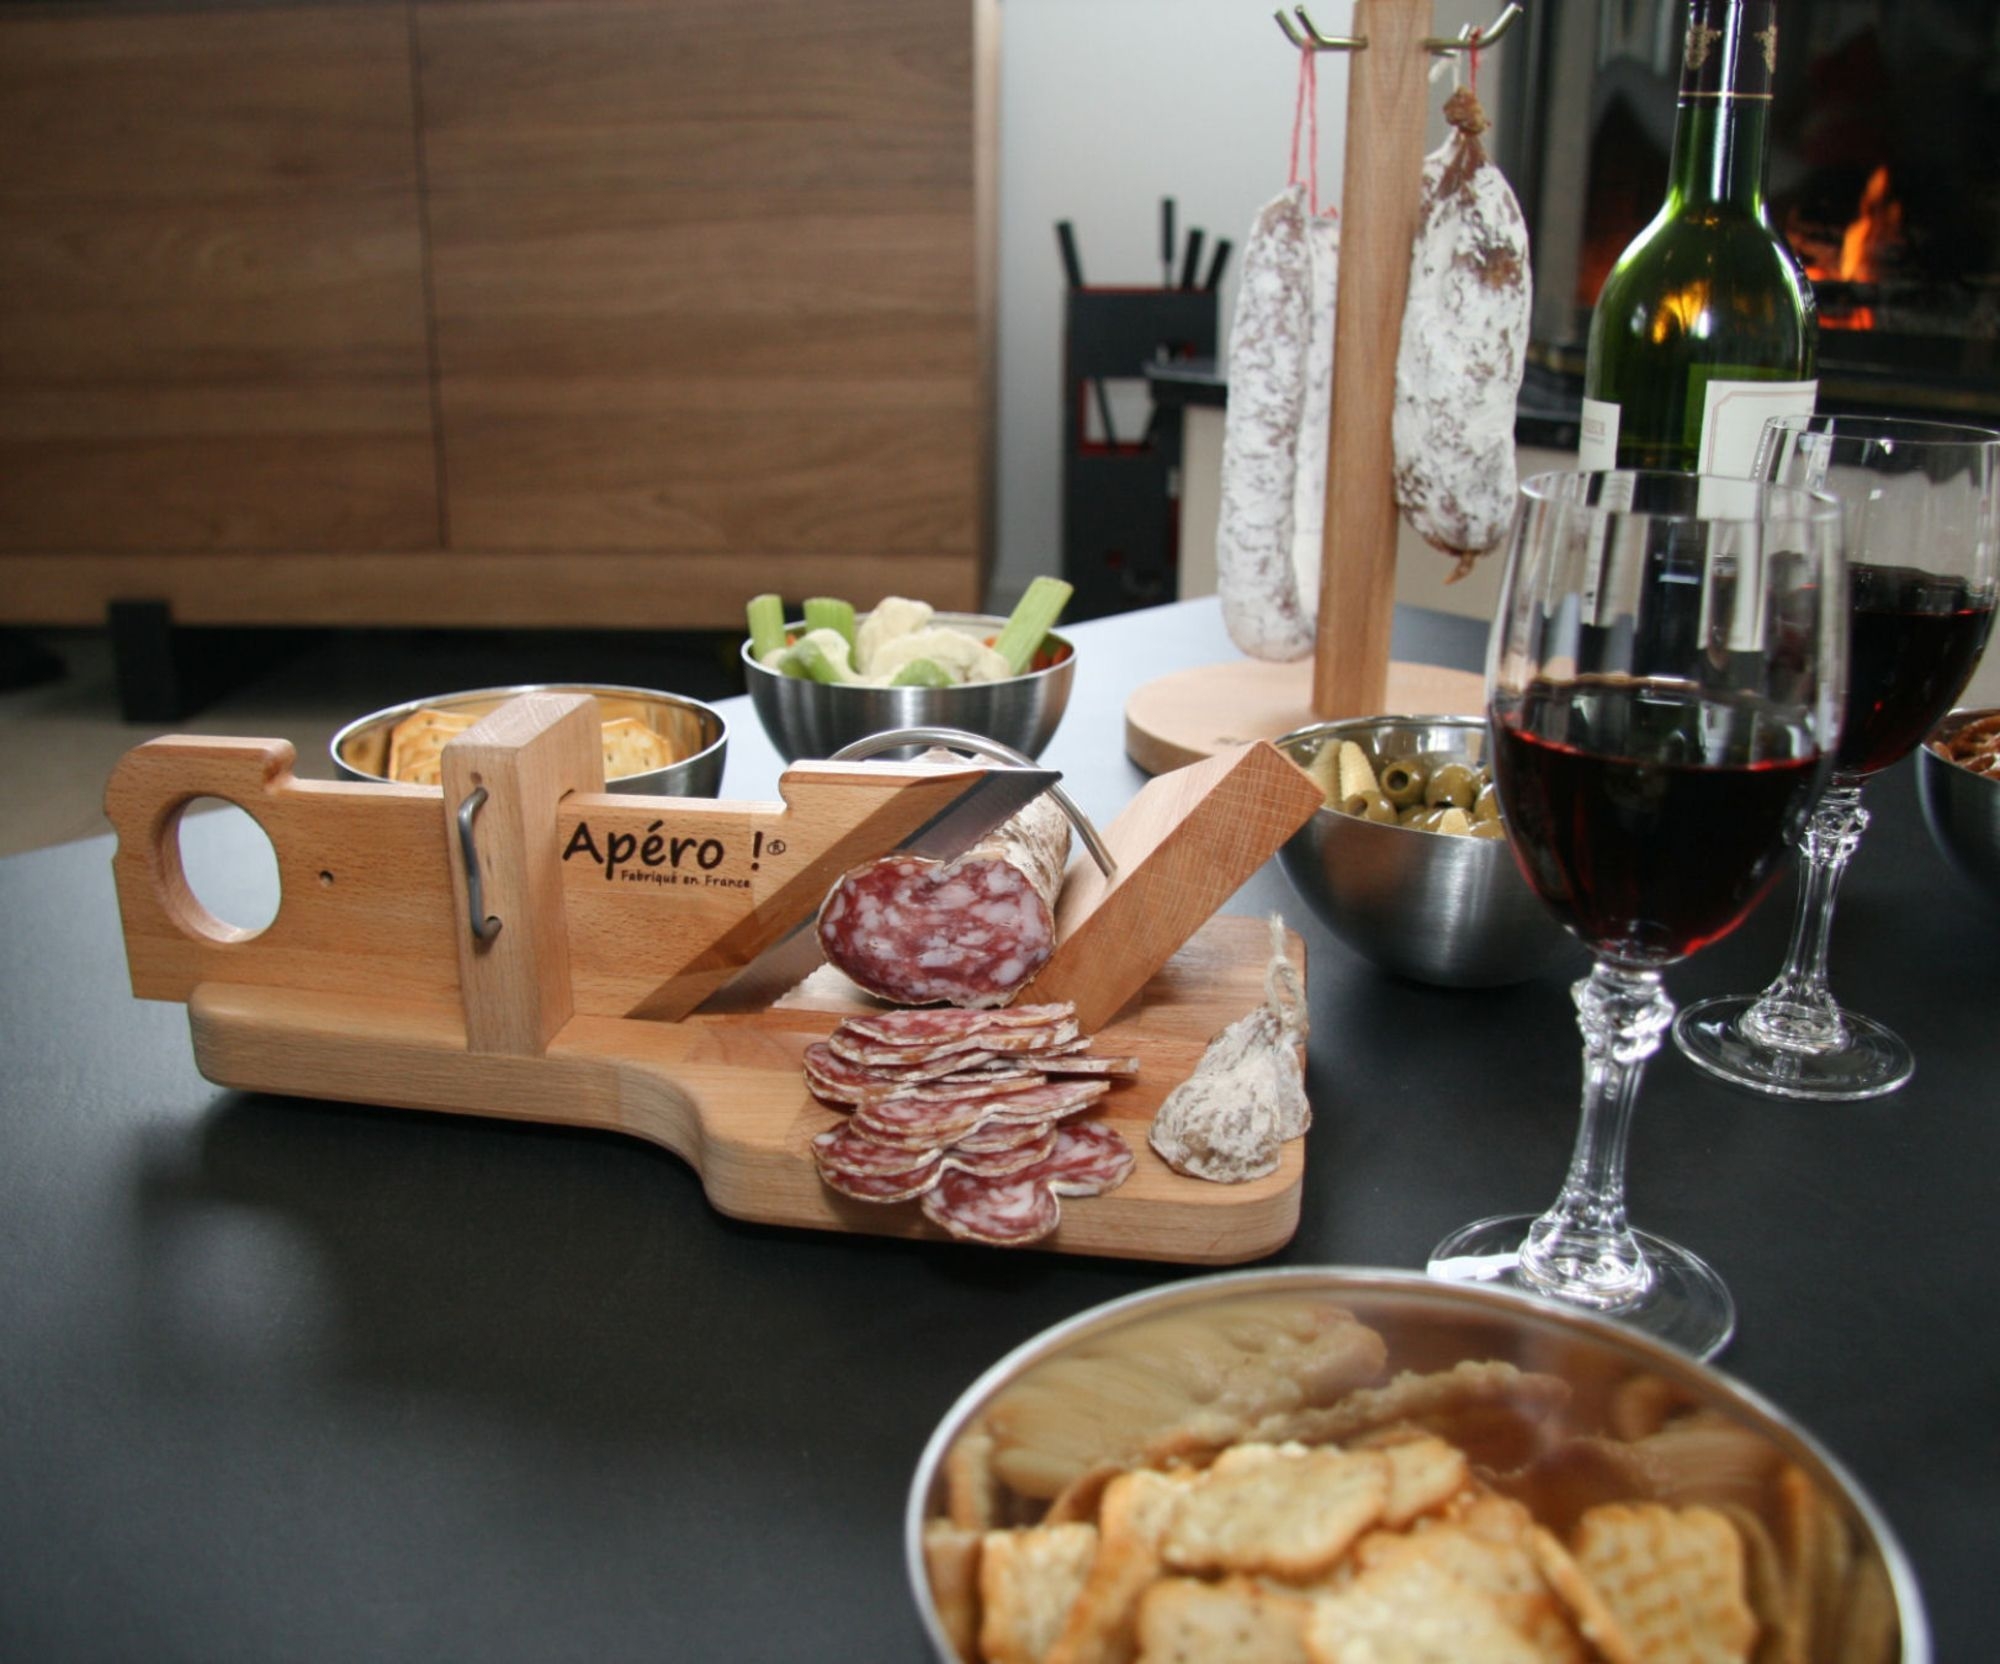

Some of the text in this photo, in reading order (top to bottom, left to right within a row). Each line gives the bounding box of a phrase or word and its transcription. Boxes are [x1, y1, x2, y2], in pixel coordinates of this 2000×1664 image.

[562, 820, 724, 880] Apéro
[683, 876, 699, 885] en
[705, 875, 750, 888] France
